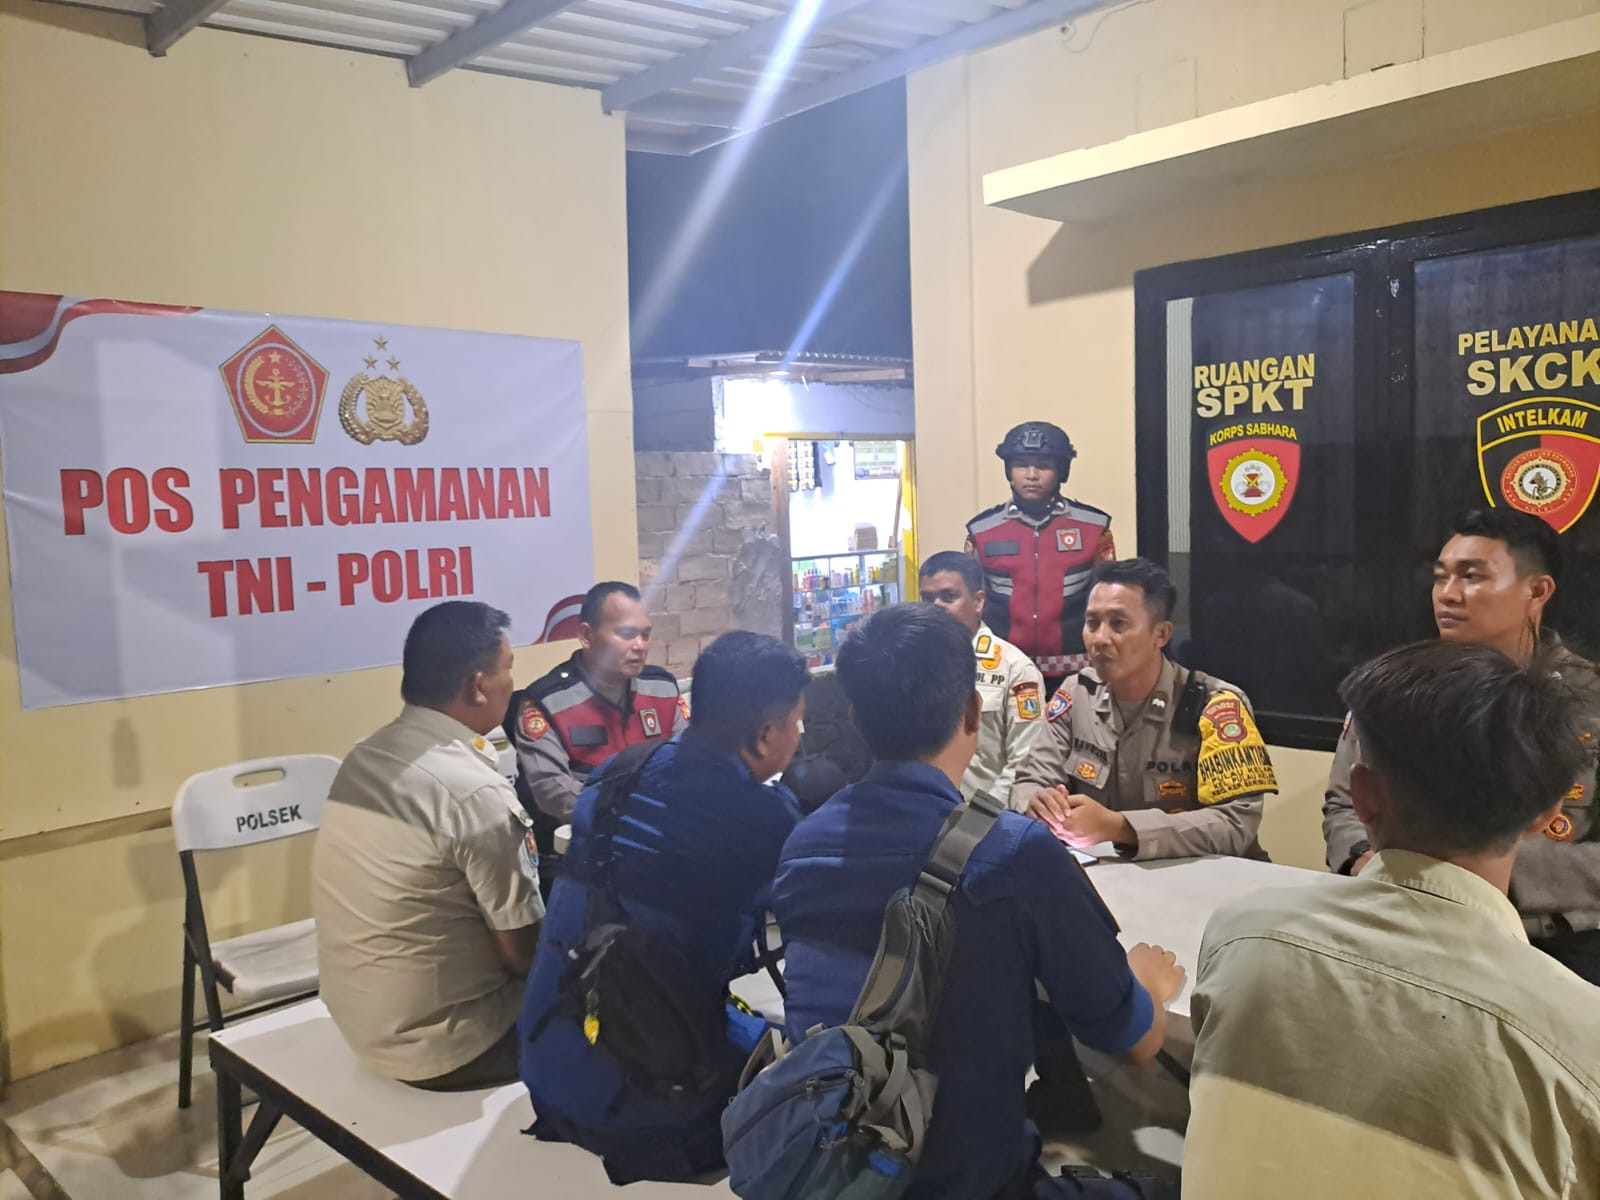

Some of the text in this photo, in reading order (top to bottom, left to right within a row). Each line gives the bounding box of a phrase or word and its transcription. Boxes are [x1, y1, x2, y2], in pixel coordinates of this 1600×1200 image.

[1458, 318, 1599, 356] PELAYANA
[1194, 353, 1315, 389] RUANGAN
[1467, 347, 1600, 396] SKCK
[1196, 378, 1313, 418] SPKT
[1209, 422, 1298, 446] KORPS SABHARA
[1497, 407, 1589, 433] INTELKAM
[60, 466, 551, 536] POS PENGAMANAN
[197, 546, 475, 618] TNI - POLRI
[991, 674, 1005, 685] PP
[1199, 745, 1272, 782] BHABINKAMTI
[236, 803, 302, 833] POLSEK
